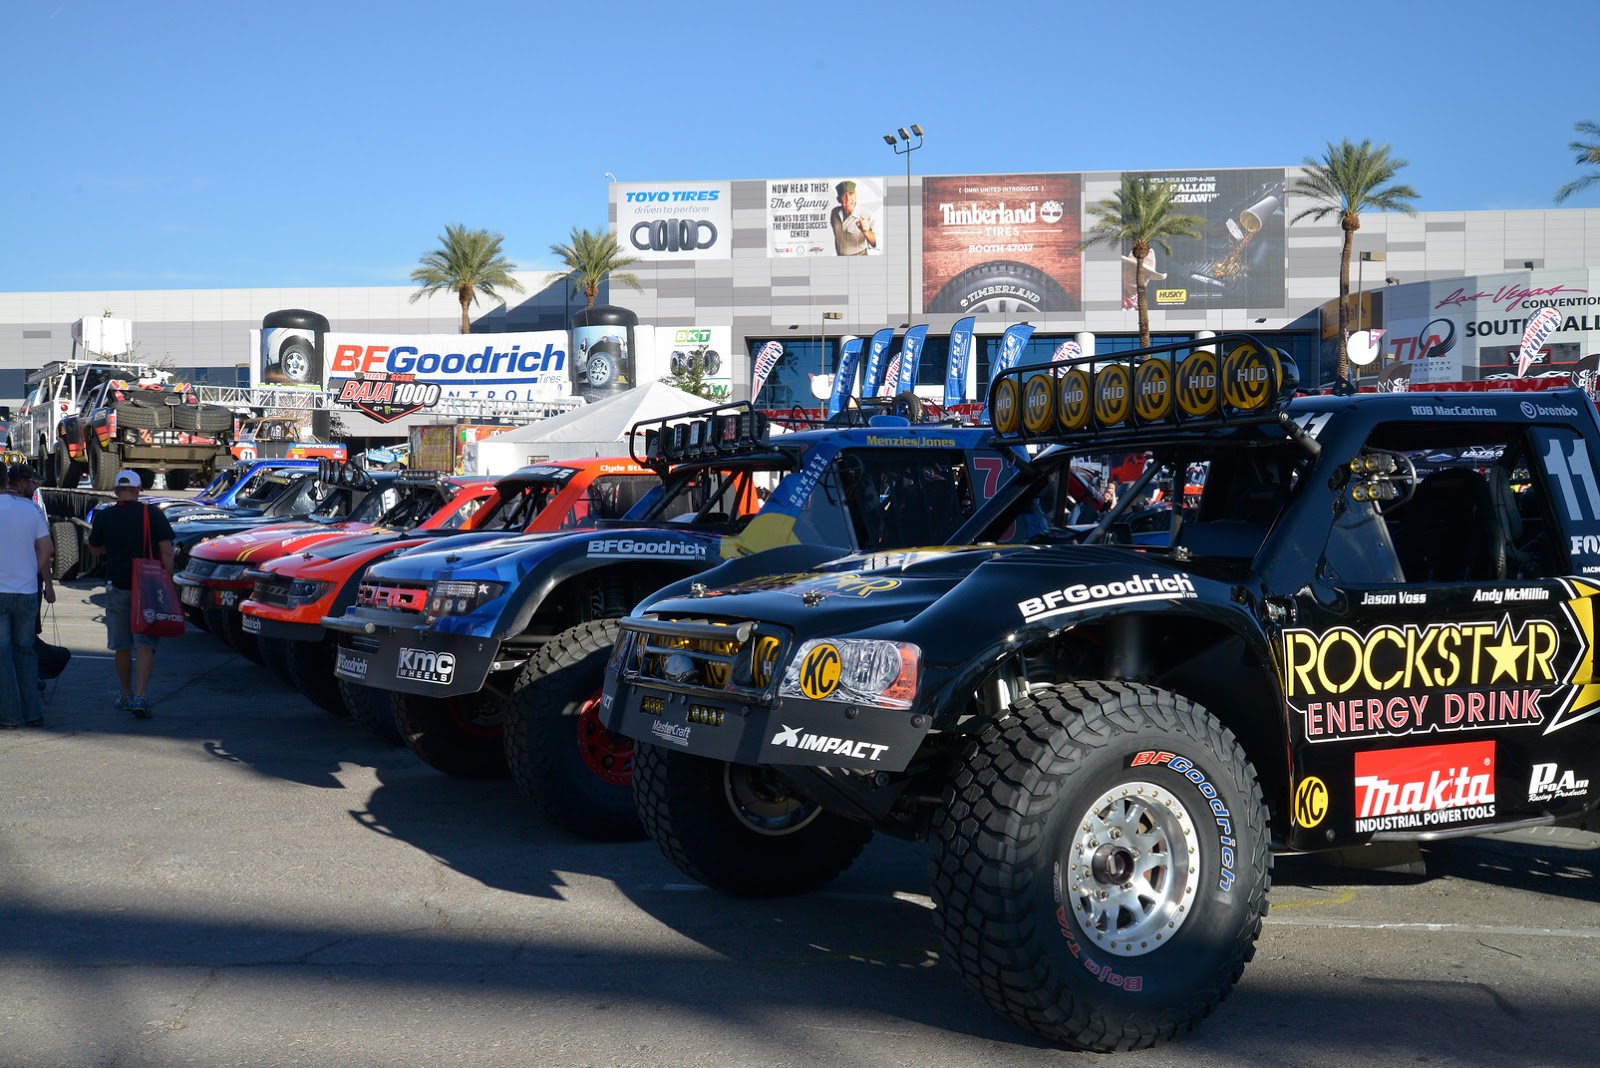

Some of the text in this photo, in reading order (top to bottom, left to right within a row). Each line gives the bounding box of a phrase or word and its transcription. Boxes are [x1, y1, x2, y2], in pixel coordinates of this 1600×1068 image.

[771, 182, 829, 194] NOW HEAR THIS!
[625, 190, 720, 203] TOYO TIRES
[770, 196, 830, 212] The Gunny
[634, 204, 710, 215] driven to perform
[773, 213, 827, 222] WANTS TO SEE YOU AT
[938, 200, 1037, 226] Timberland
[772, 221, 828, 231] THE OFFROAD SUCCESS
[790, 230, 810, 238] CENTER
[984, 226, 1020, 237] TIRES
[969, 243, 1035, 254] BOOTH 47017
[967, 284, 1041, 303] TIMBERLAND
[1158, 291, 1184, 299] HUSKY
[1434, 284, 1588, 313] Las Vegas
[1521, 297, 1600, 309] CONVENTIO
[1556, 314, 1600, 332] ALL
[675, 329, 711, 343] BKT
[1523, 314, 1562, 359] FORCE
[950, 332, 963, 377] KING
[1390, 334, 1447, 362] TIA
[330, 343, 566, 374] BFGoodrich
[868, 343, 883, 384] KING
[901, 338, 916, 383] KING
[389, 373, 416, 382] SCORE
[538, 373, 561, 384] Tires
[1188, 374, 1217, 389] HID
[1236, 367, 1269, 383] HID
[339, 380, 441, 406] BAJA 1000
[1102, 386, 1126, 401] HID
[1141, 380, 1168, 396] HID
[997, 398, 1012, 411] HID
[1028, 394, 1048, 408] HID
[1063, 389, 1085, 404] HID
[1410, 405, 1498, 416] ROB MacCachren
[1535, 404, 1579, 416] brembo
[139, 428, 153, 444] 76
[866, 435, 956, 448] Menzies/Jones
[243, 451, 253, 460] 71
[599, 465, 625, 473] Clyde
[795, 458, 828, 508] WATCHES
[973, 456, 1004, 499] 7
[1543, 438, 1600, 521] 11
[587, 539, 707, 556] BFGoodrich
[1017, 572, 1197, 618] BFGoodrich
[1360, 591, 1427, 605] Jason Voss
[1472, 588, 1549, 604] Andy McMillin
[155, 612, 184, 622] SPYDE
[400, 668, 448, 682] WHEELS
[802, 646, 839, 696] KC
[1307, 688, 1541, 736] ENERGY DRINK
[651, 719, 692, 738] MasterCraft
[1298, 779, 1325, 822] KC
[1527, 788, 1588, 803] Racing Products
[1130, 750, 1236, 892] BFGoodrich
[1355, 805, 1496, 833] INDUSTRIAL POWER TOOLS
[1083, 958, 1143, 991] Baja
